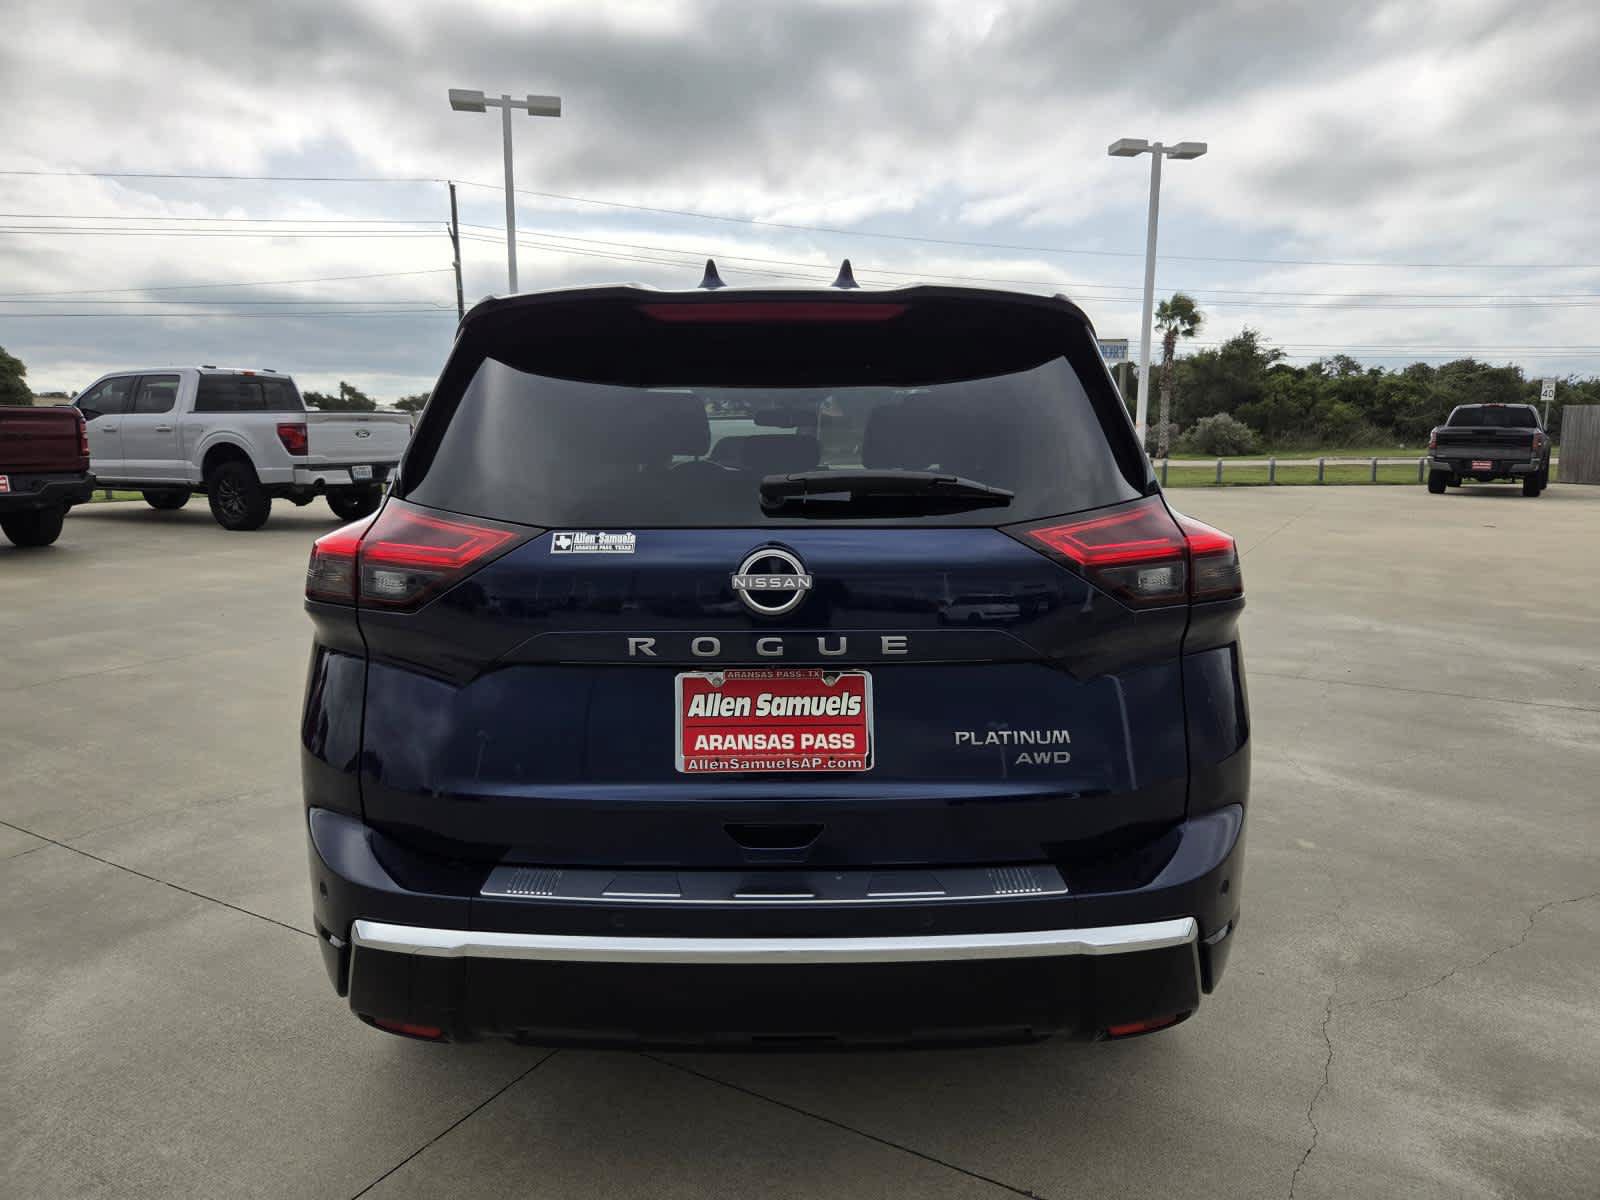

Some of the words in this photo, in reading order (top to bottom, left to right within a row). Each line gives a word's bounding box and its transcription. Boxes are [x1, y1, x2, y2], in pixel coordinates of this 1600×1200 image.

[1542, 389, 1554, 398] 40
[734, 577, 812, 588] NISSAN
[627, 636, 909, 657] ROGUE
[727, 671, 774, 679] ARANSAS
[808, 670, 820, 678] TX
[687, 692, 751, 717] Allen
[755, 692, 861, 717] Samuels
[694, 734, 795, 751] ARANSAS
[801, 733, 855, 750] PASS
[954, 730, 1071, 745] PLATINUM
[687, 757, 862, 770] AllenSamuelsAP.com
[1015, 751, 1071, 765] AWD
